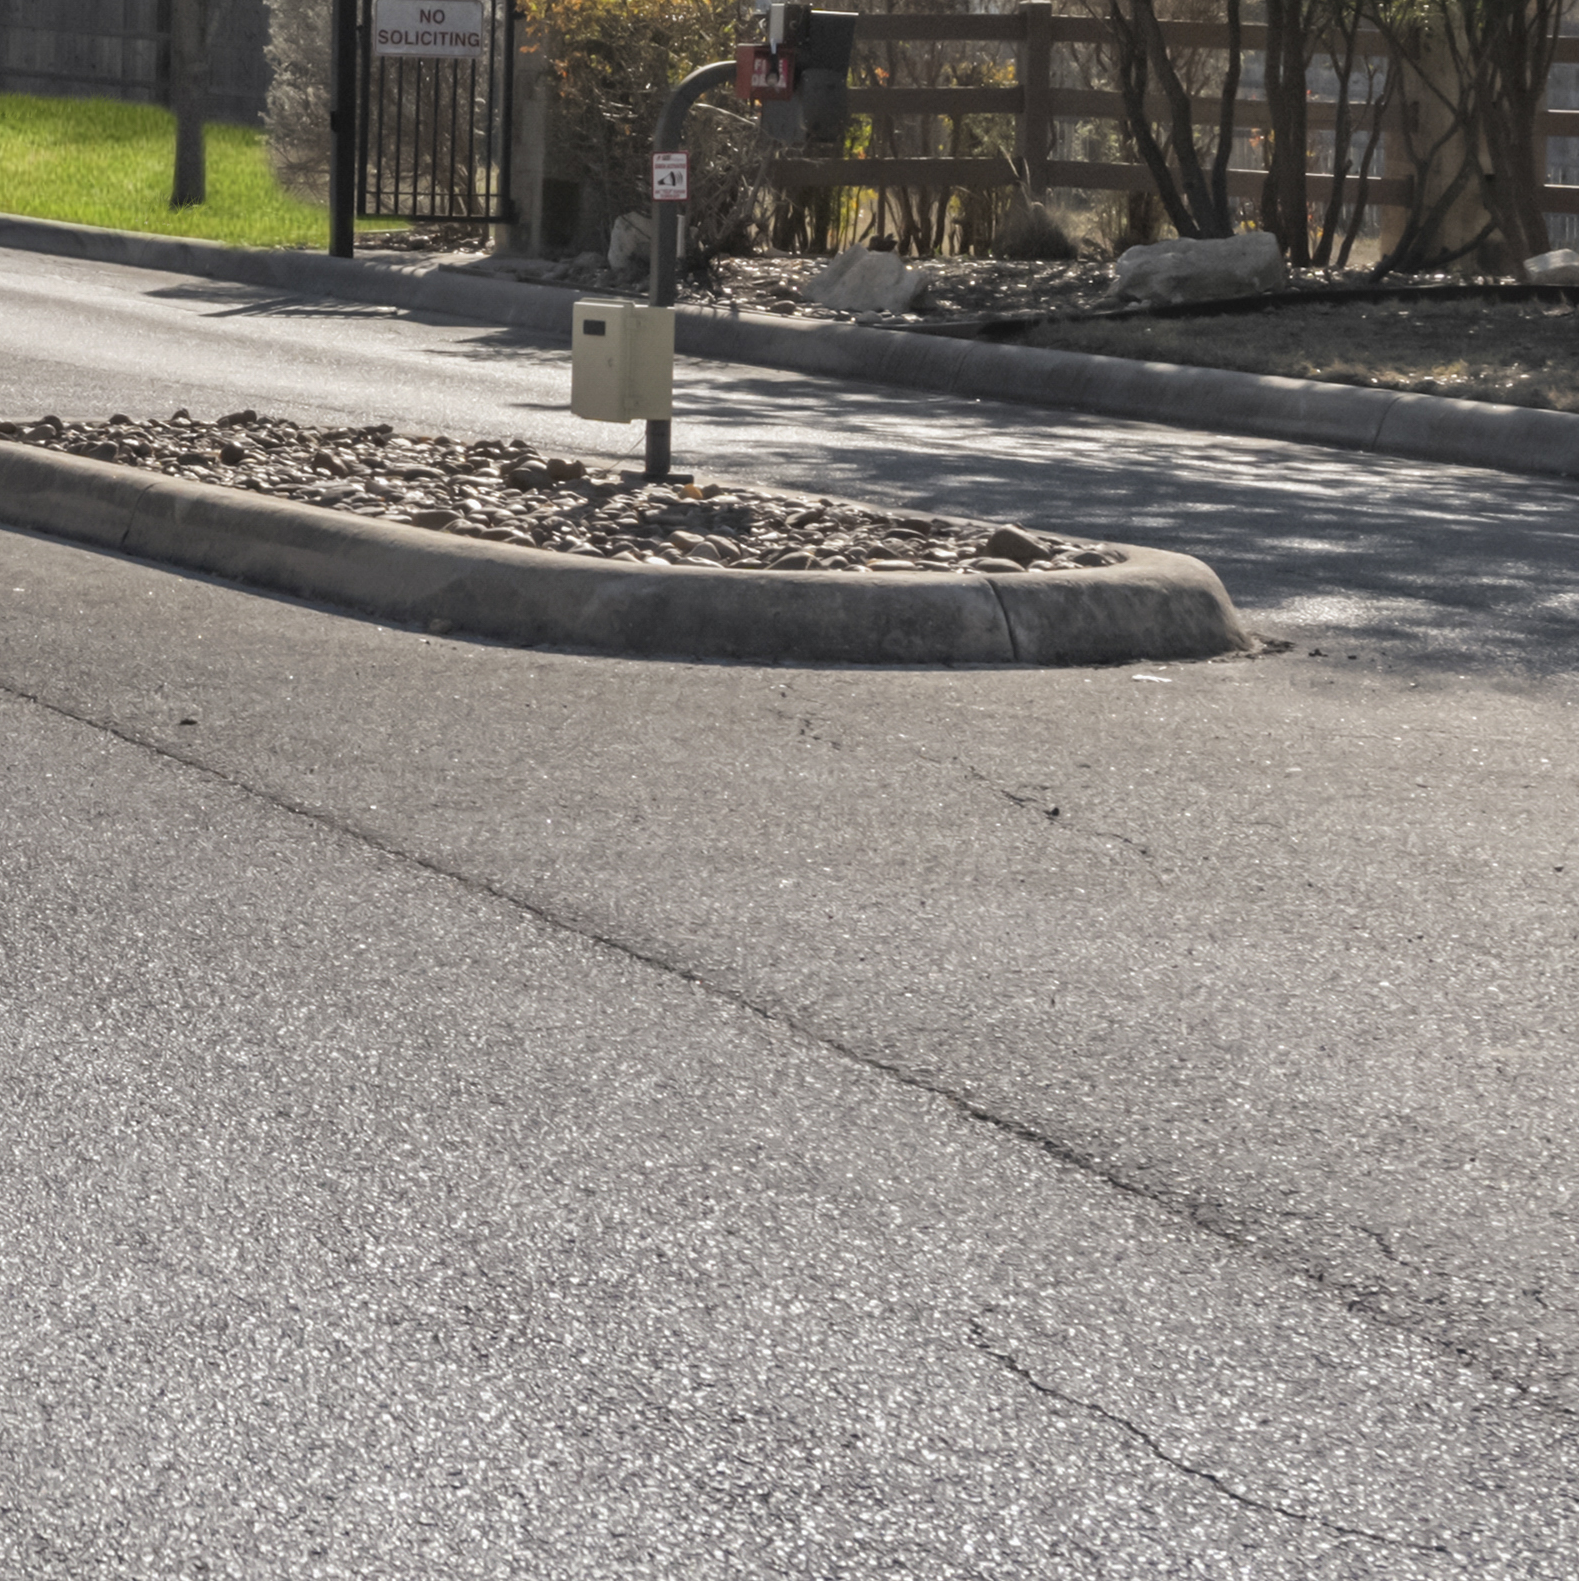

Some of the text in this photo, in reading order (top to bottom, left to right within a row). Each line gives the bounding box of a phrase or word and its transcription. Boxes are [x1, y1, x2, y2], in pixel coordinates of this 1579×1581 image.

[419, 9, 446, 25] NO
[378, 29, 480, 47] SOLICITING
[754, 59, 783, 72] FI
